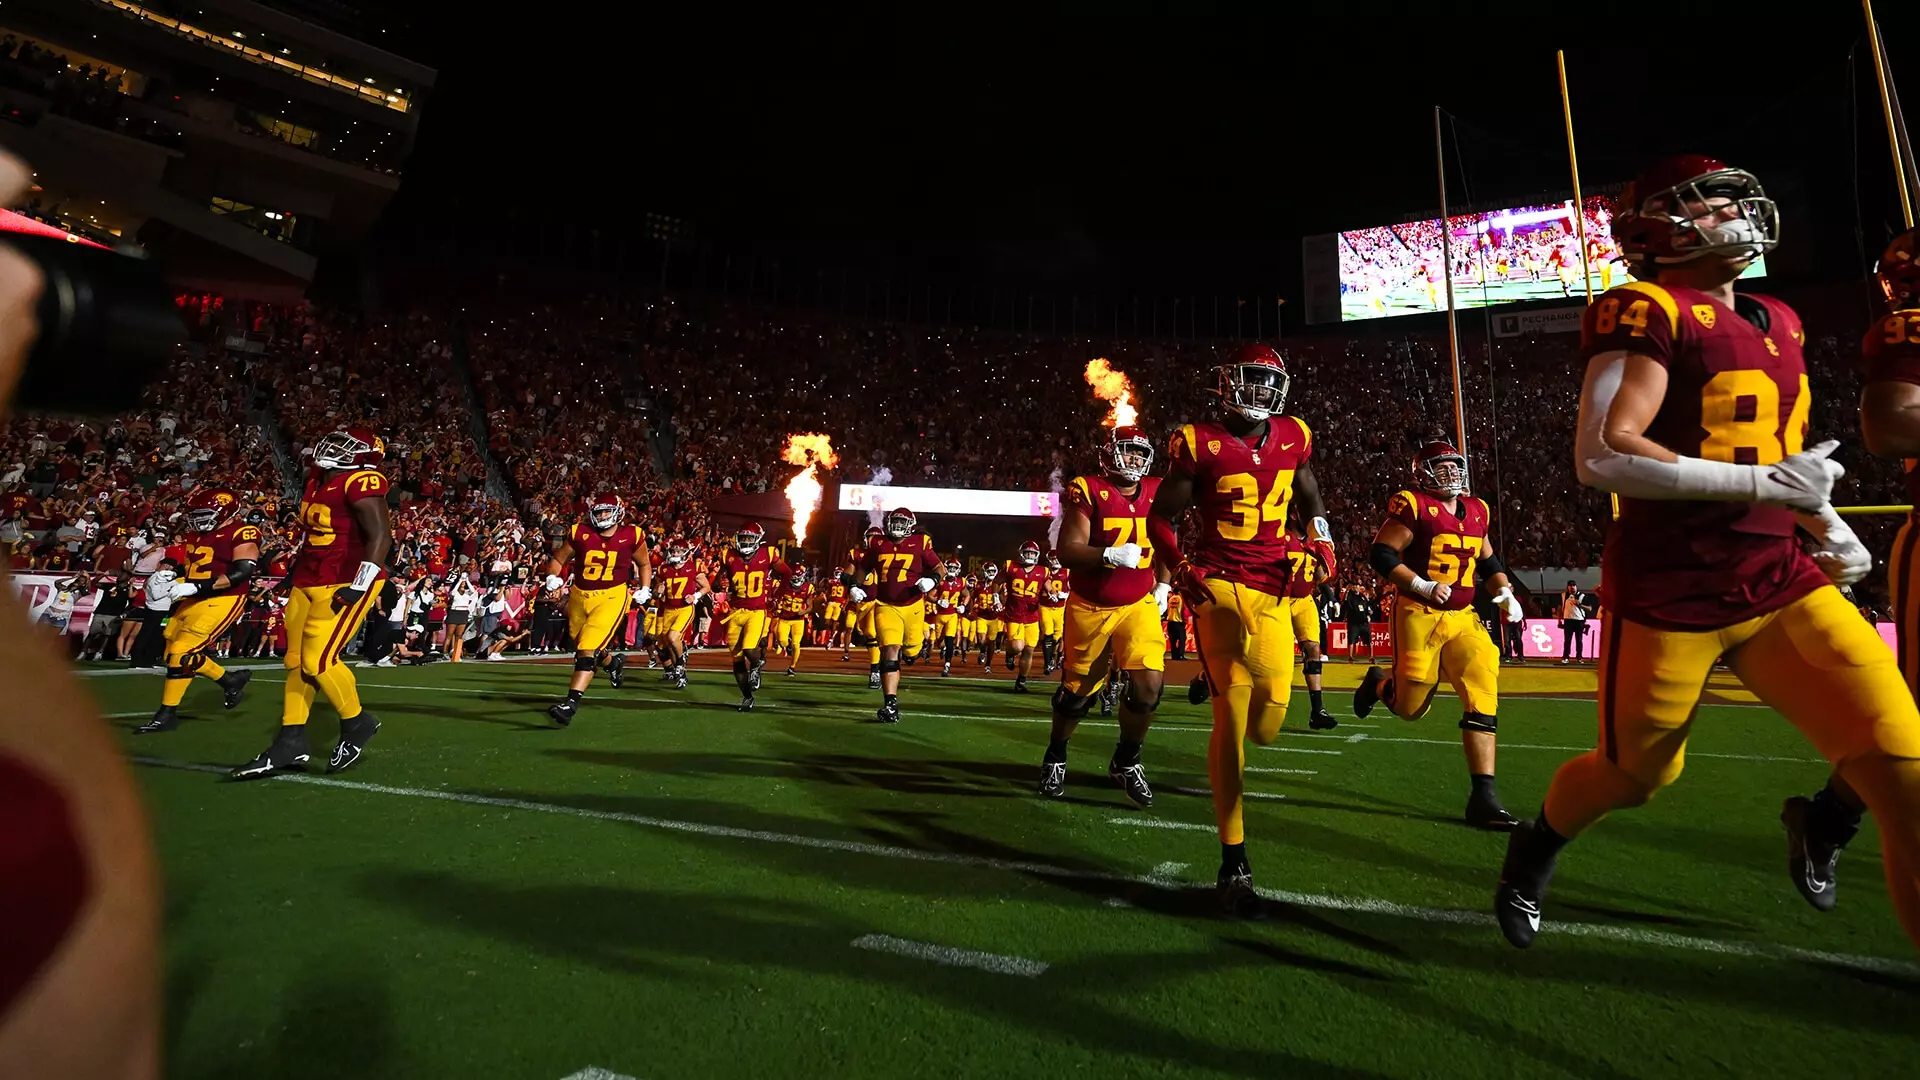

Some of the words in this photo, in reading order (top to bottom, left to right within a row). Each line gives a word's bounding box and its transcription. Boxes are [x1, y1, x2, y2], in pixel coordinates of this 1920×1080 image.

[1522, 311, 1580, 324] PECHANGA
[1596, 298, 1651, 337] 84
[358, 476, 380, 492] 79
[1216, 469, 1295, 541] 34
[1389, 494, 1408, 516] 67
[243, 528, 257, 540] 62
[583, 550, 618, 581] 61
[878, 554, 914, 582] 77
[1287, 551, 1318, 583] 76
[1427, 534, 1484, 587] 67
[666, 577, 688, 599] 17
[732, 571, 764, 598] 40
[831, 585, 844, 598] 89
[1012, 579, 1038, 598] 94
[1531, 624, 1552, 652] SC
